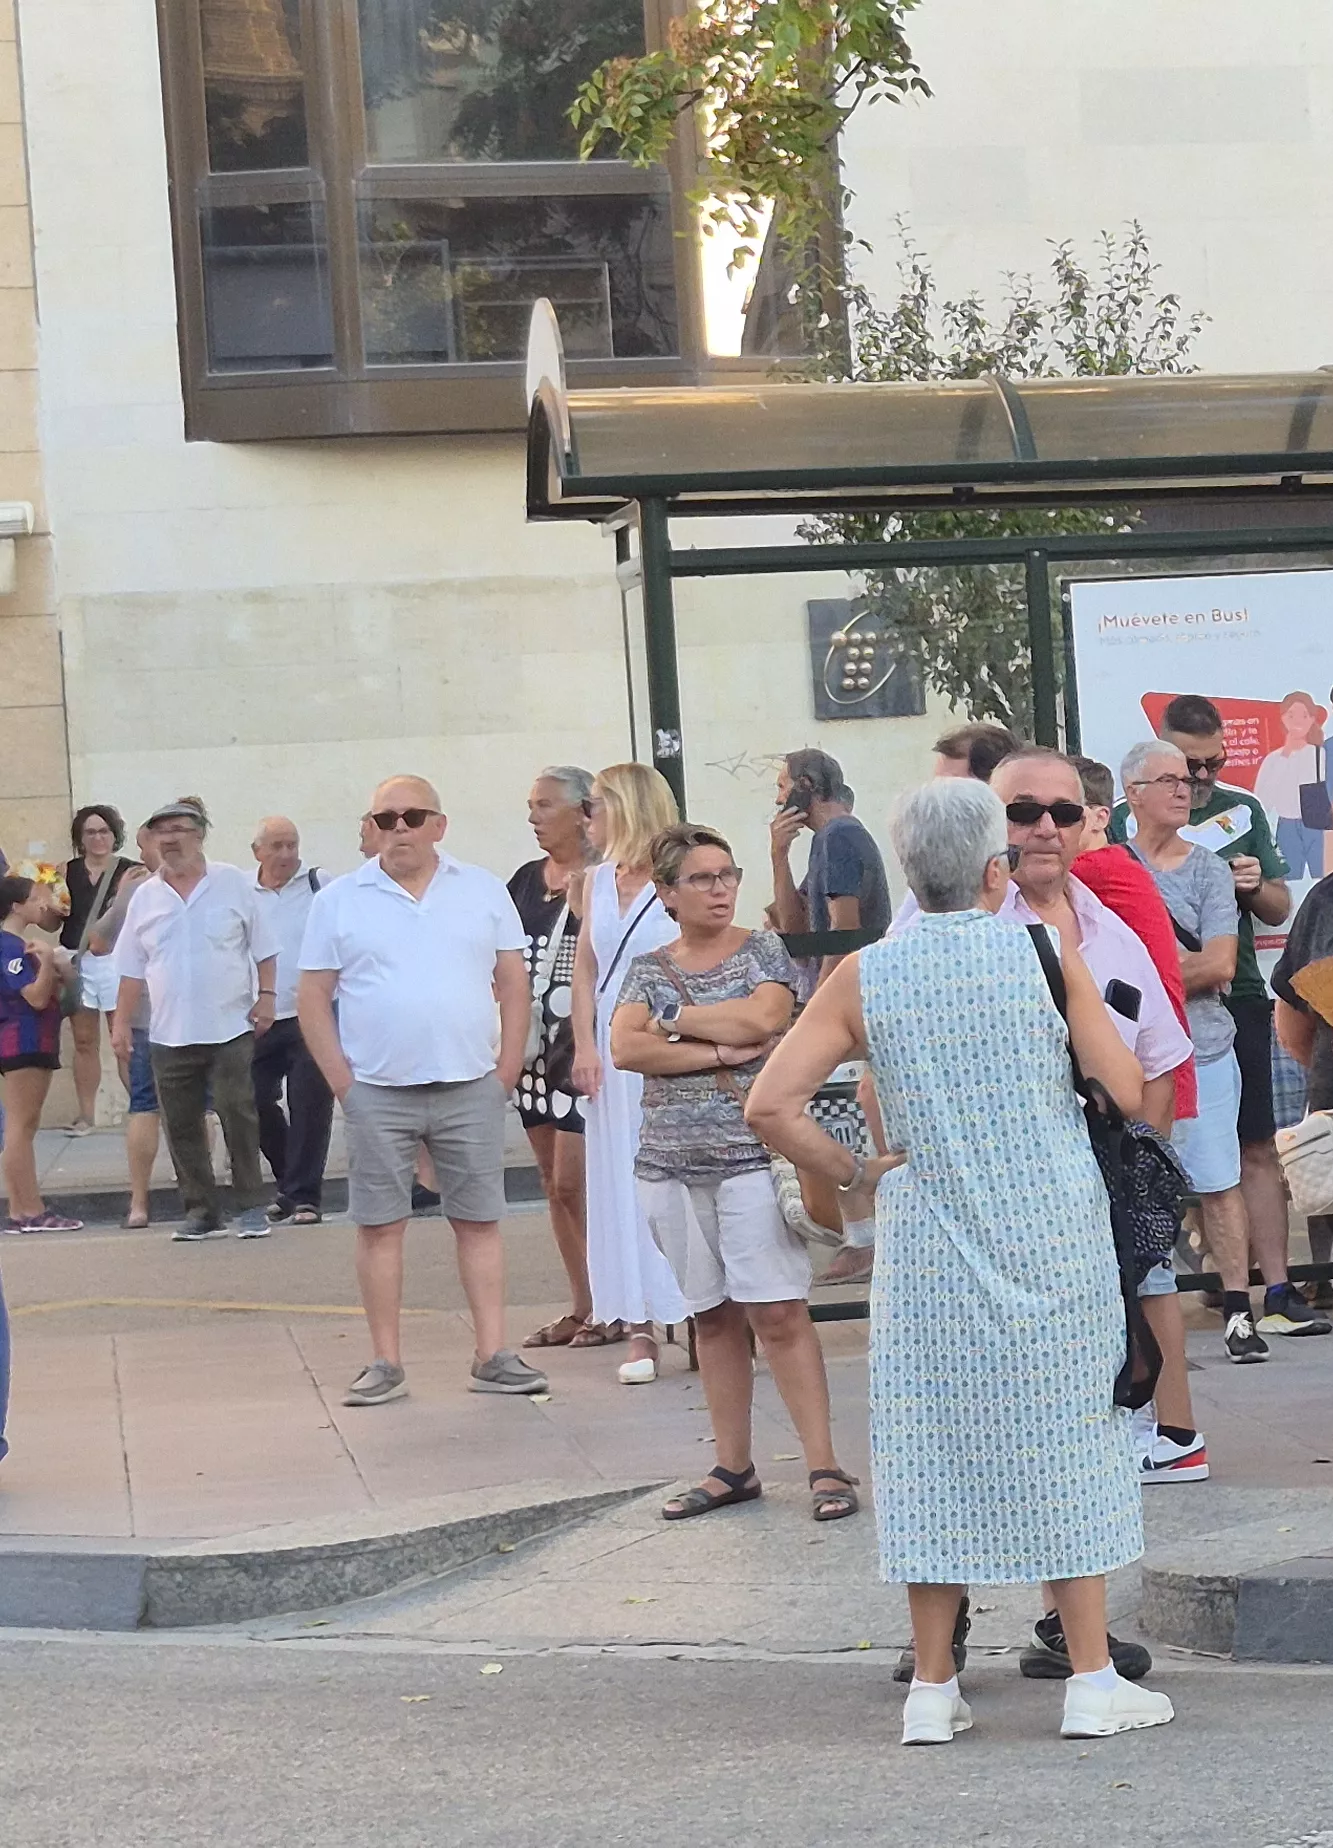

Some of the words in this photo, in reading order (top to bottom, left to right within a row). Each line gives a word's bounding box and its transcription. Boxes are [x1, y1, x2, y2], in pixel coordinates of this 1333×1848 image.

[1098, 612, 1179, 633] ¡Muévete
[1185, 613, 1205, 624] en
[1211, 608, 1249, 622] Bus!
